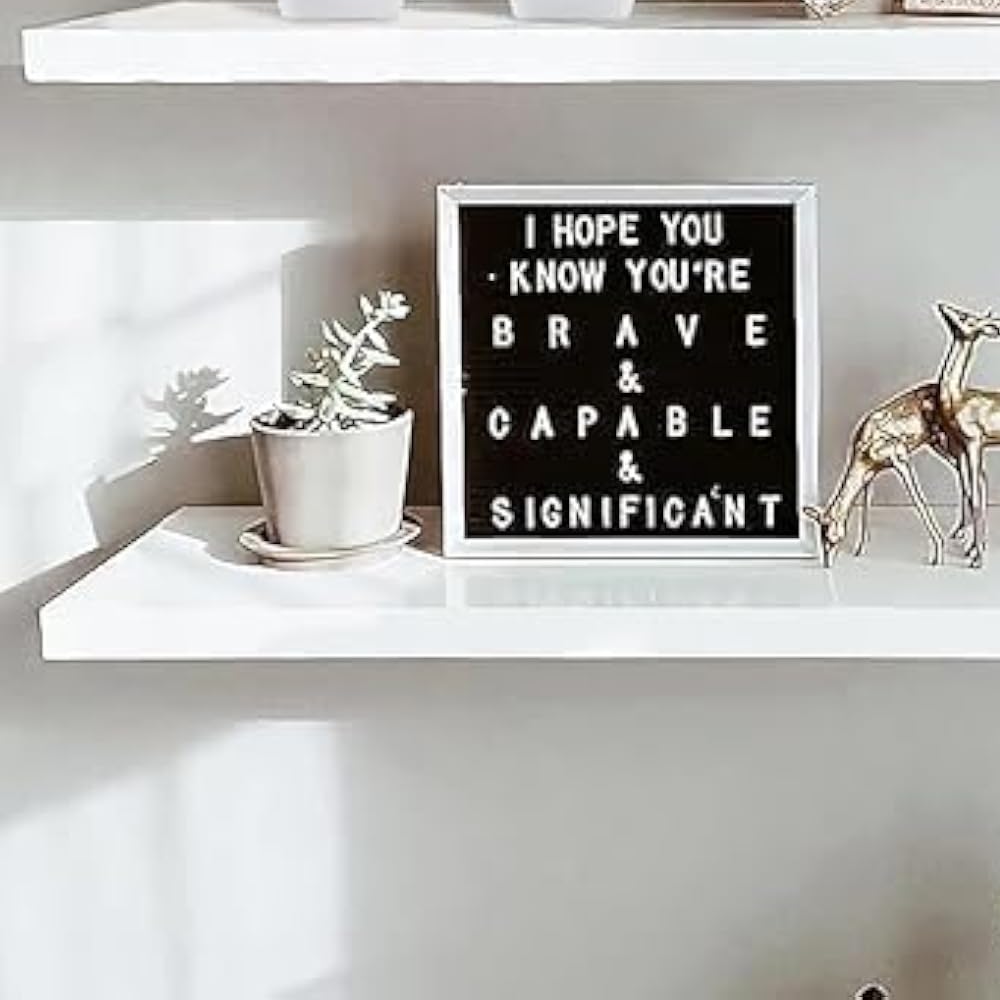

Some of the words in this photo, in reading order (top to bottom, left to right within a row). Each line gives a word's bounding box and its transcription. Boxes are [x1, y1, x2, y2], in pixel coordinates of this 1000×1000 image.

[524, 213, 536, 249] I
[552, 212, 640, 249] HOPE
[659, 211, 724, 246] YOU
[509, 258, 607, 295] KNOW
[624, 257, 751, 293] YOU'RE
[491, 313, 768, 349] BRAVE
[617, 360, 643, 394] &
[487, 405, 772, 441] CAPABLE
[617, 449, 643, 484] &
[490, 492, 783, 530] SIGNIFICANT
